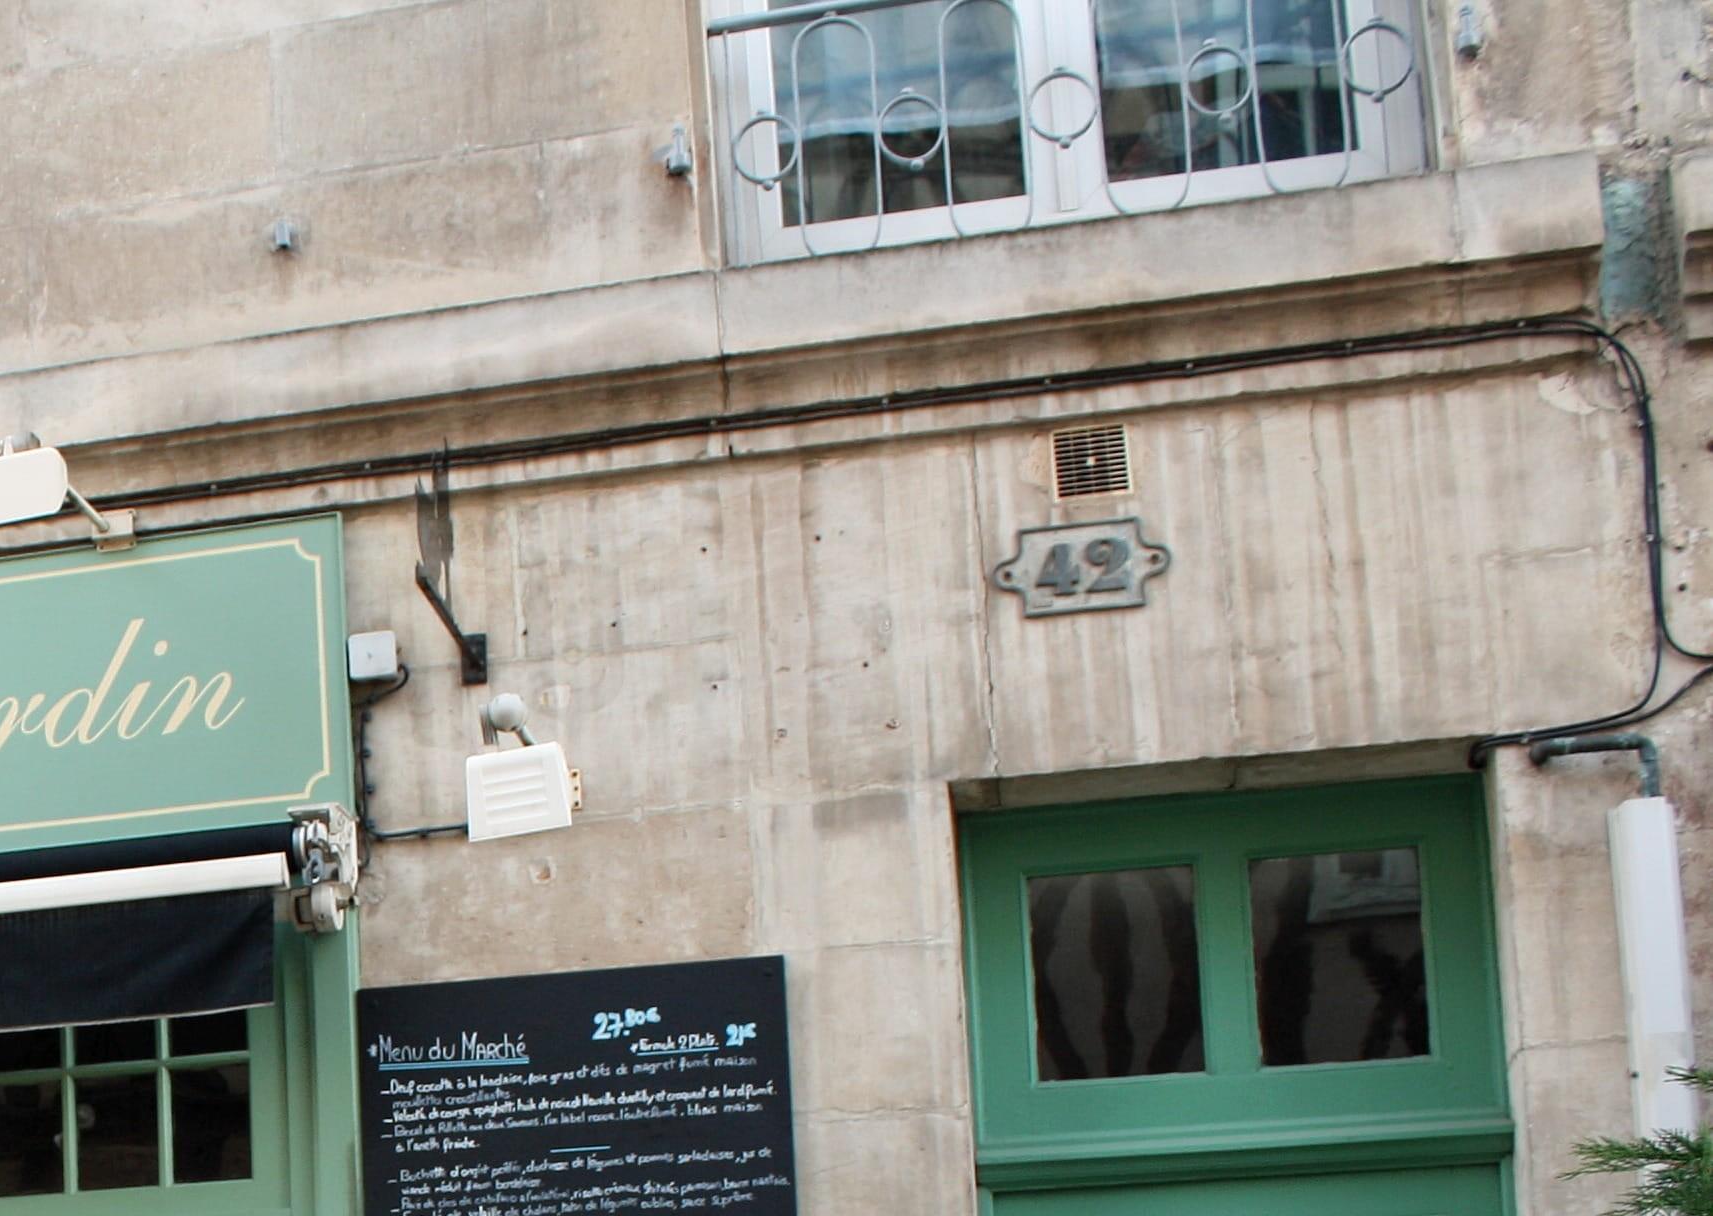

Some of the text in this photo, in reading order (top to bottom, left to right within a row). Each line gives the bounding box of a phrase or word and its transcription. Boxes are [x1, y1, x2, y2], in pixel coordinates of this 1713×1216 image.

[1036, 536, 1138, 597] 42
[379, 1034, 424, 1063] Menu
[428, 1037, 455, 1060] du
